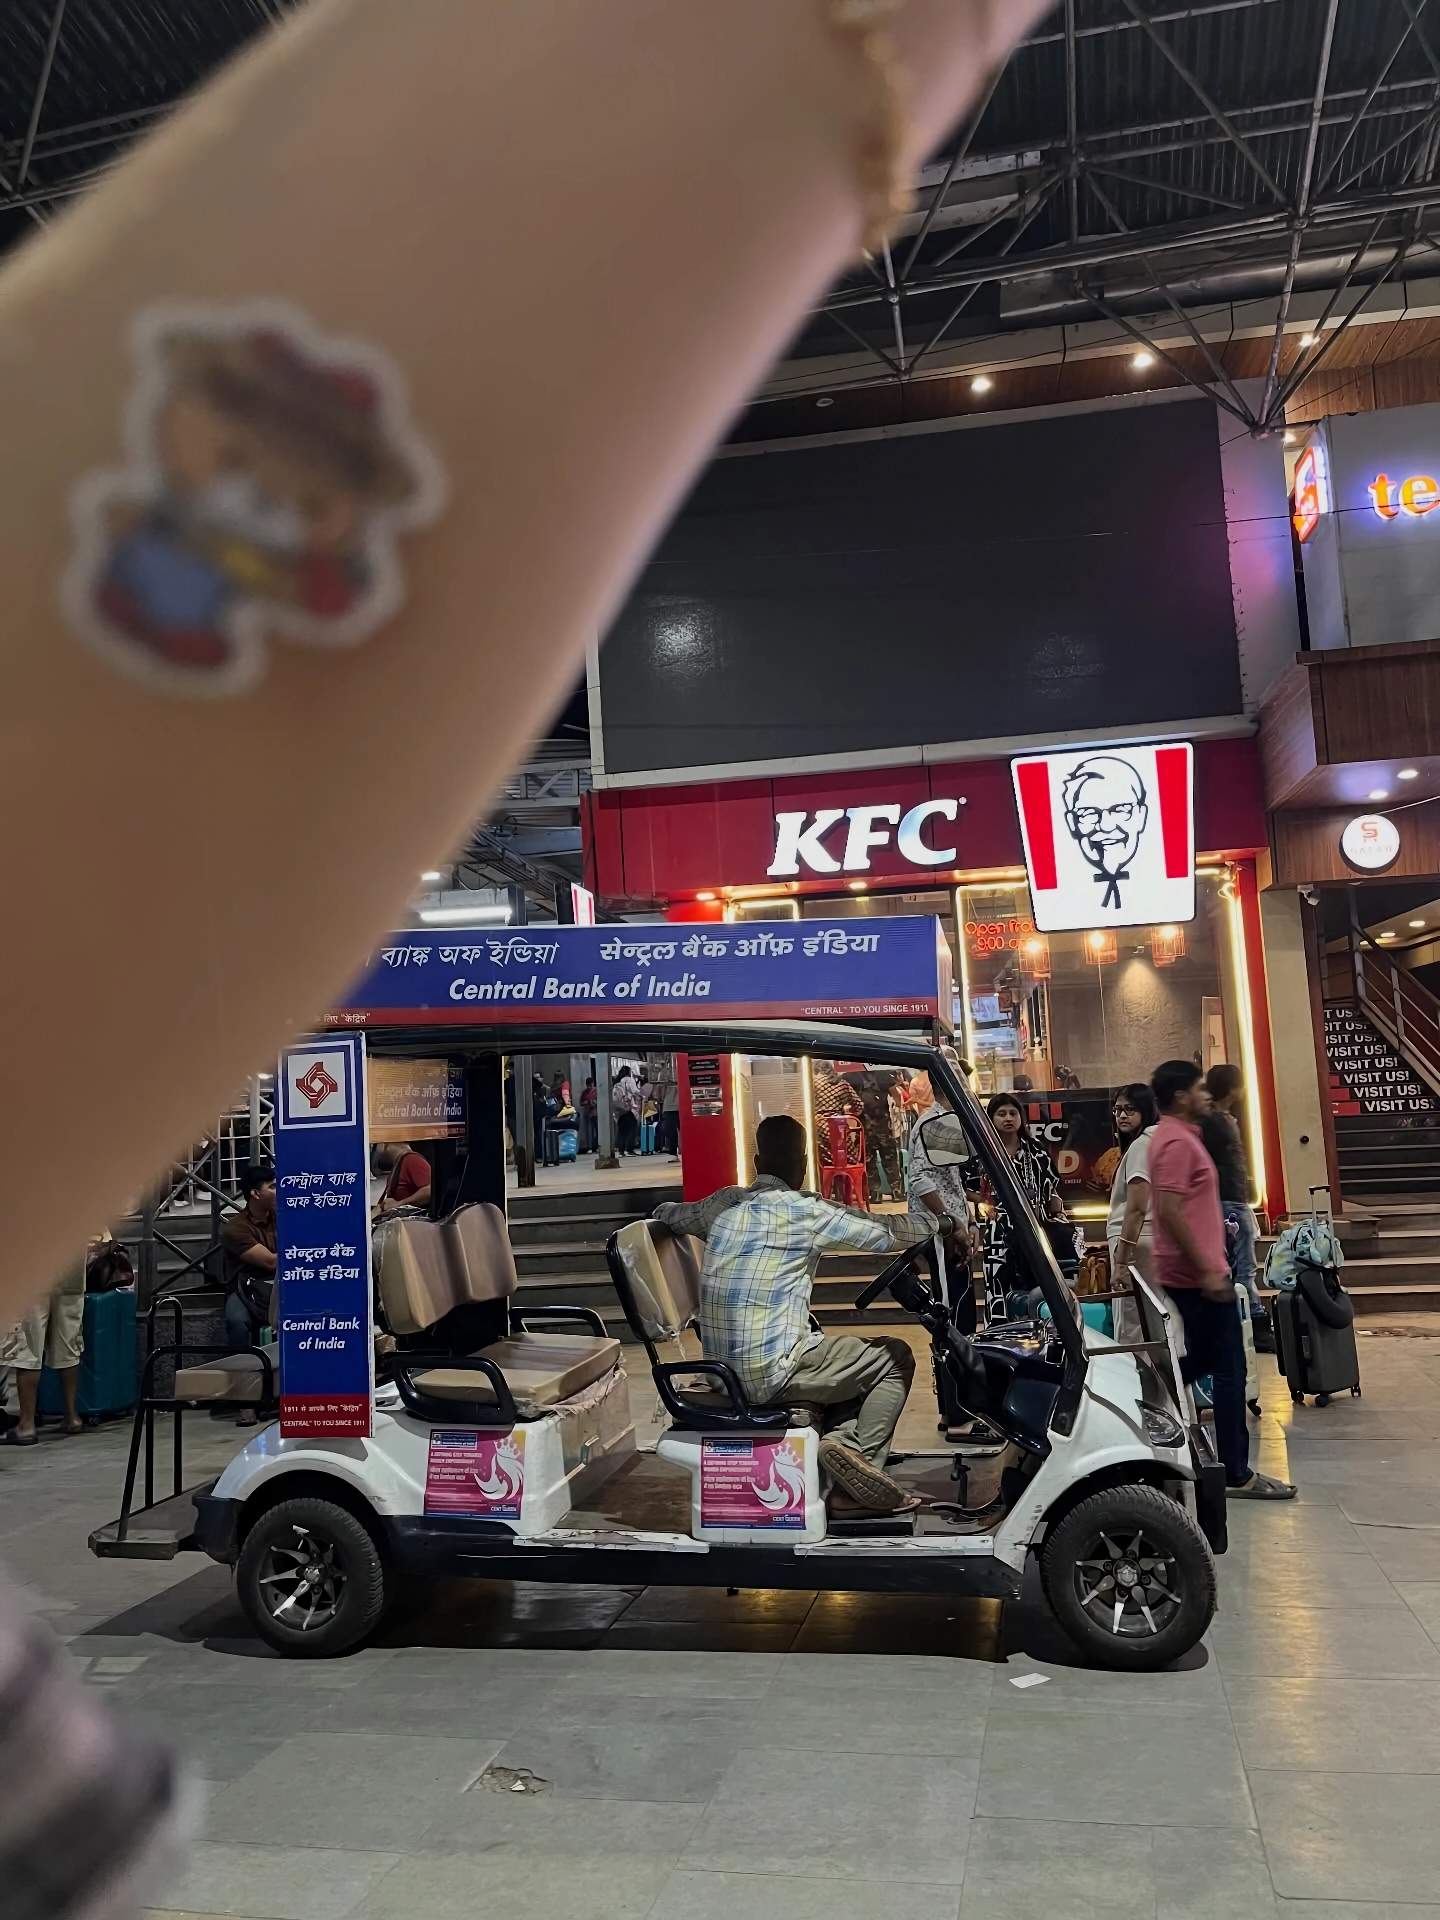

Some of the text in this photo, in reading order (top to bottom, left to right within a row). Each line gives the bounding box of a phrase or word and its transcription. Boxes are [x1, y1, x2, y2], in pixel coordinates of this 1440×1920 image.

[766, 798, 959, 876] KFC
[438, 945, 484, 966] অফ
[485, 936, 560, 968] ইন্ডিয়া
[600, 936, 678, 967] सेन्ट्रल
[682, 934, 729, 958] बैंक
[802, 928, 880, 958] इंडिया
[449, 972, 711, 1000] Central Bank of India
[849, 1005, 862, 1014] TO
[863, 1005, 881, 1014] YOU
[882, 1004, 909, 1014] SINCE
[910, 1004, 929, 1013] 1911
[1326, 1034, 1351, 1044] ISIT
[1326, 1045, 1387, 1057] VISIT US!
[1334, 1057, 1398, 1070] VISIT US!
[1344, 1071, 1410, 1084] VISIT US!
[1353, 1085, 1422, 1098] VISIT US!
[411, 1103, 431, 1117] Bank
[433, 1103, 442, 1116] of
[443, 1102, 462, 1116] India
[1364, 1100, 1405, 1112] VISIT
[286, 1191, 352, 1208] অফ ইন্ডিয়া
[285, 1243, 357, 1262] सेन्ट्रल बैंक
[319, 1265, 360, 1281] इंडिया
[283, 1317, 360, 1331] Central Bank
[299, 1336, 345, 1349] of India
